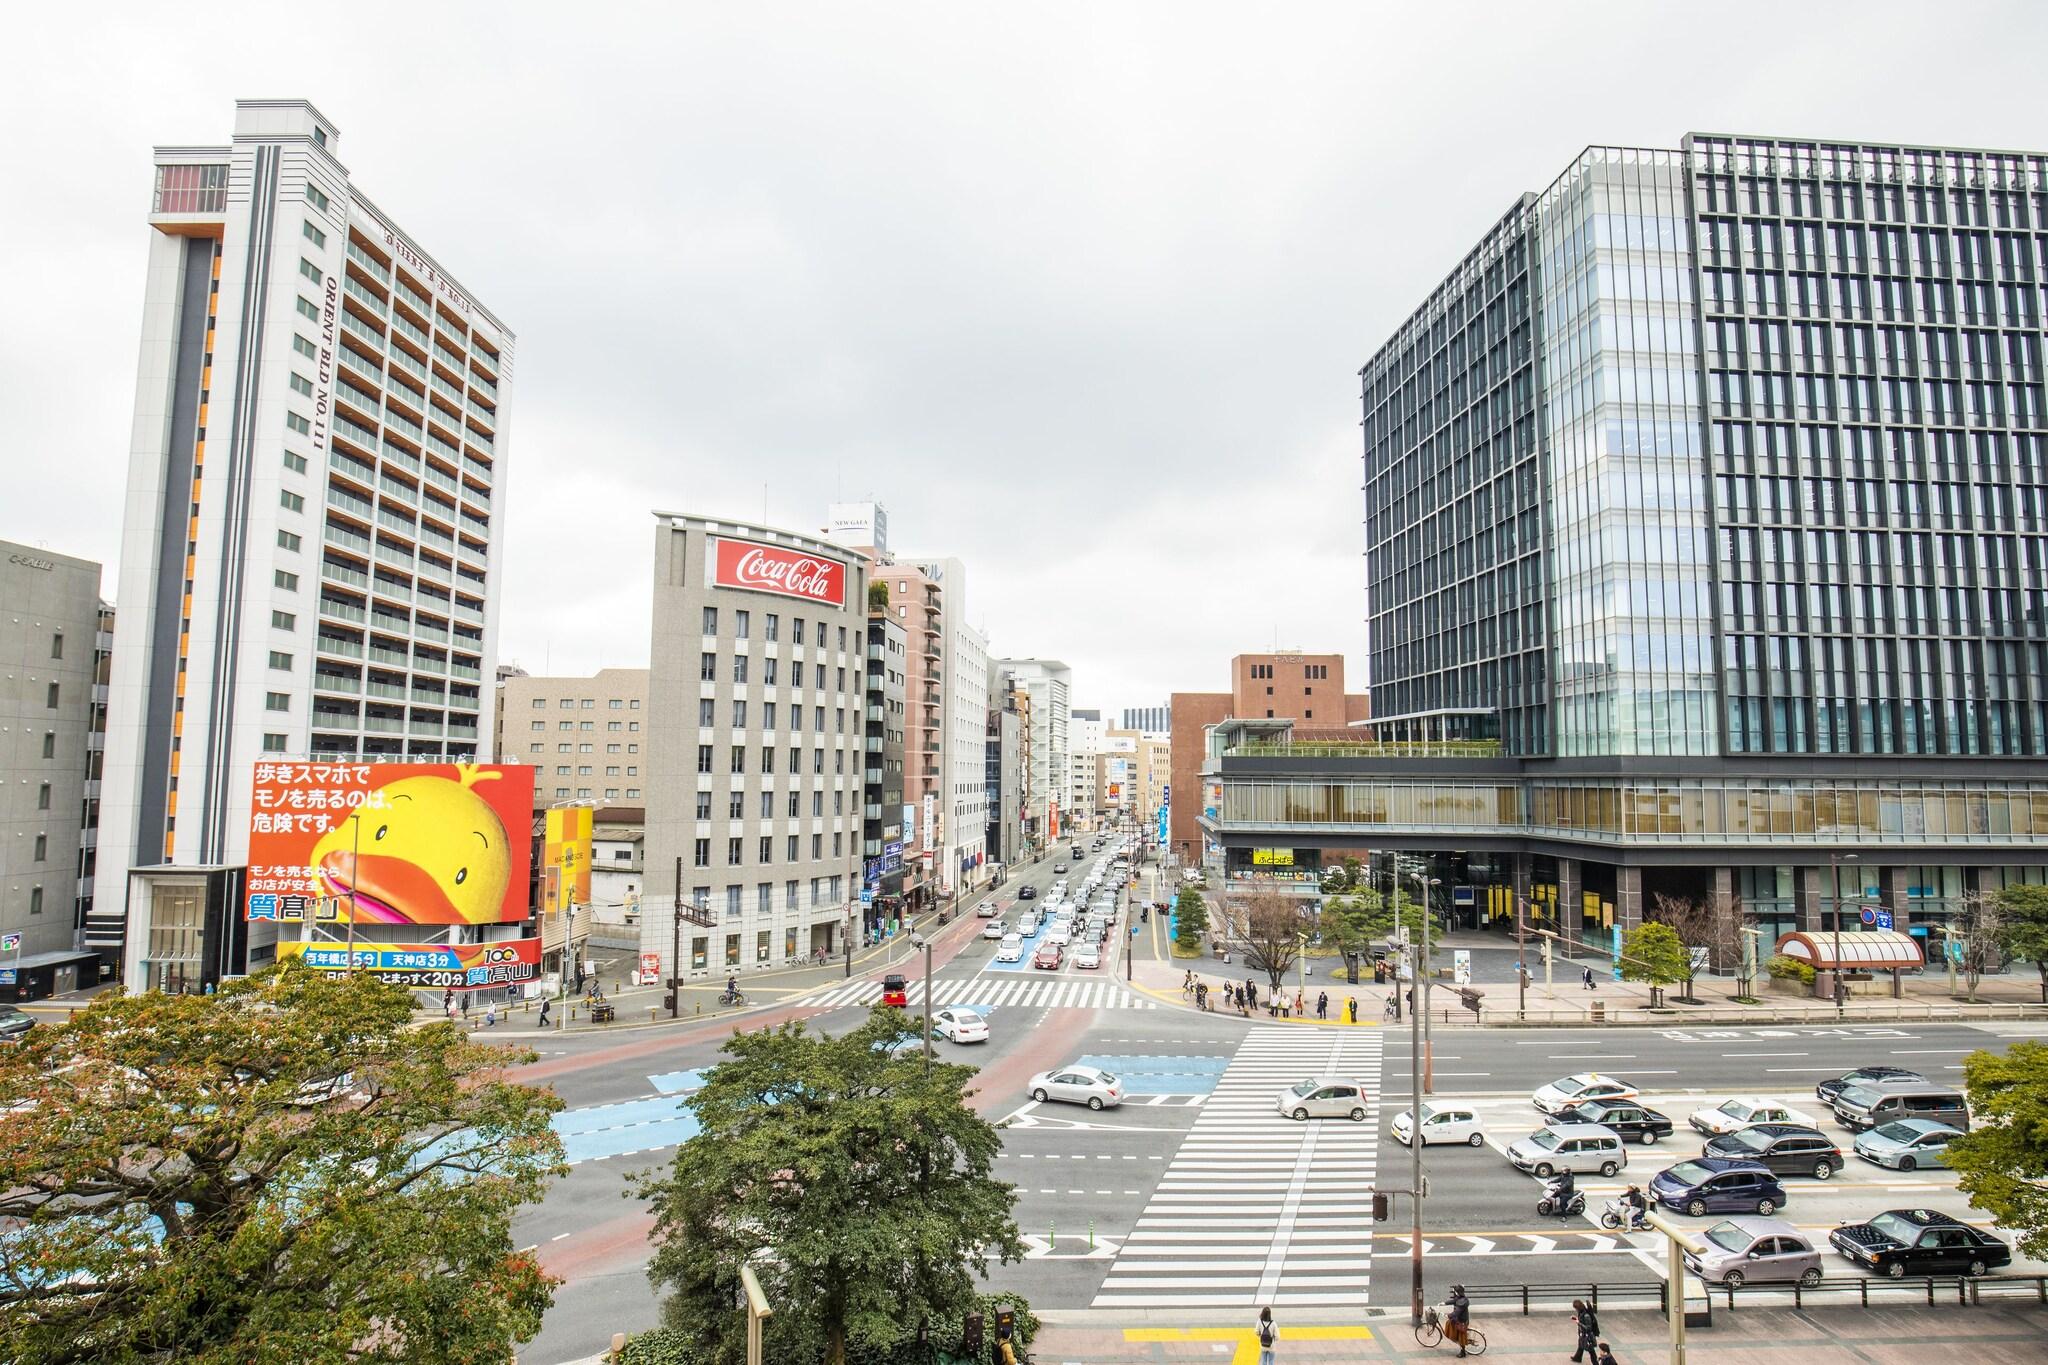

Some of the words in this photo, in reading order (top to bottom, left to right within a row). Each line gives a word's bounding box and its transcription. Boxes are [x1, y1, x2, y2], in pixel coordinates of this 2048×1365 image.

[321, 276, 337, 345] ORIENT
[318, 346, 332, 384] BLD
[313, 388, 328, 450] NO.111
[736, 548, 833, 597] Coca-Cola
[255, 764, 371, 785] 歩きスマホで
[254, 788, 394, 810] モノを売るのは、
[252, 812, 337, 834] 危険です。
[249, 865, 345, 878] モノを売るなら、
[248, 878, 325, 891] お店が安全。
[392, 953, 449, 967] 天神店3分
